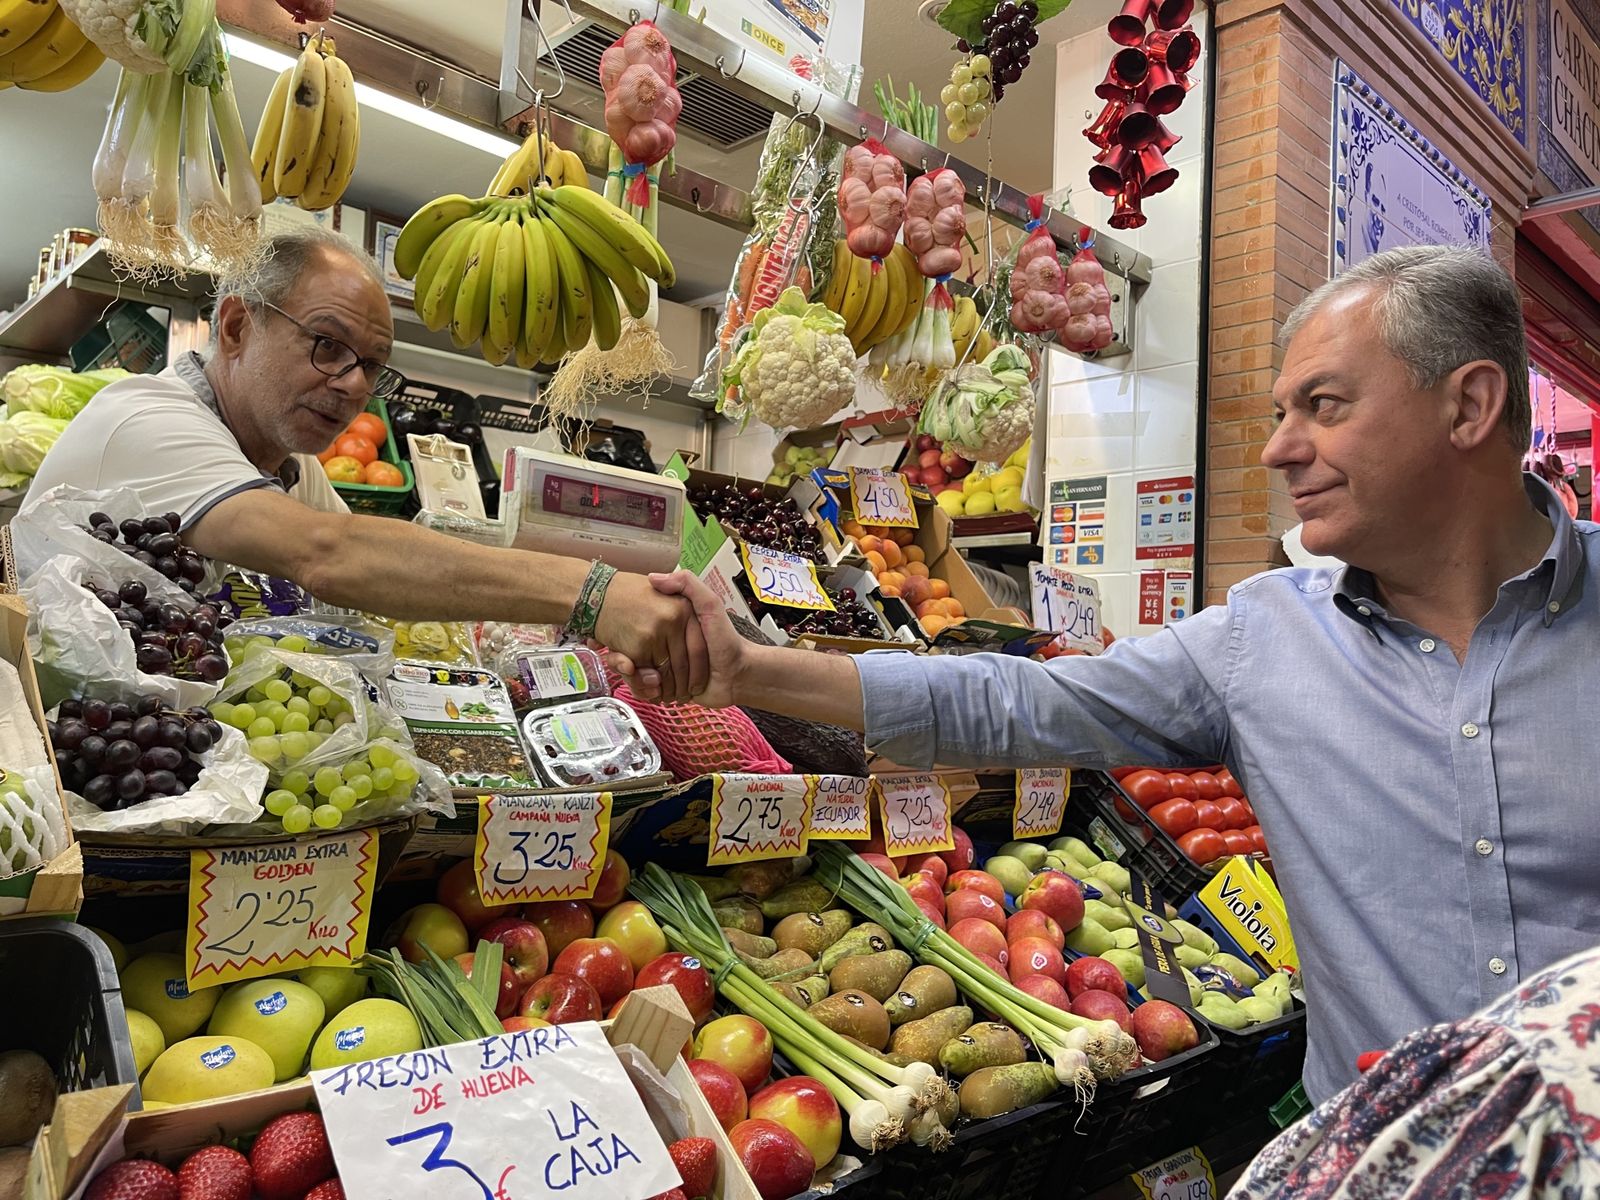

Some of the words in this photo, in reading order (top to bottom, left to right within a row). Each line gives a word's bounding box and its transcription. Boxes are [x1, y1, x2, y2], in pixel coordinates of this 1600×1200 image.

[754, 29, 784, 54] ONCE
[1555, 75, 1600, 171] CHACI
[550, 480, 558, 489] kg
[1077, 484, 1103, 494] FERNANDO
[863, 483, 899, 518] 4'50
[760, 566, 803, 597] 2'50
[1035, 570, 1058, 587] TOMATE
[1050, 567, 1074, 582] OFERTA
[412, 727, 448, 735] ESPINACAS
[465, 729, 504, 737] GARBANZOS
[746, 782, 785, 793] NACIONAL
[820, 776, 866, 794] CACAO
[564, 796, 594, 810] KANZI
[815, 806, 860, 824] ECUADOR
[1016, 791, 1055, 826] 2'49
[509, 808, 550, 824] CAMPAÑA
[555, 812, 580, 823] NUEVA
[722, 797, 784, 843] 2'75
[892, 795, 932, 840] 3'25
[220, 846, 296, 866] MANZANA
[304, 842, 349, 860] EXTRA
[493, 832, 576, 884] 3'25
[254, 862, 315, 884] GOLDEN
[205, 886, 318, 956] 2'25
[480, 1024, 578, 1071] EXTRA
[412, 1084, 447, 1116] DE
[462, 1065, 535, 1100] HUELVA
[547, 1100, 600, 1142] LA
[544, 1133, 642, 1190] CAJA
